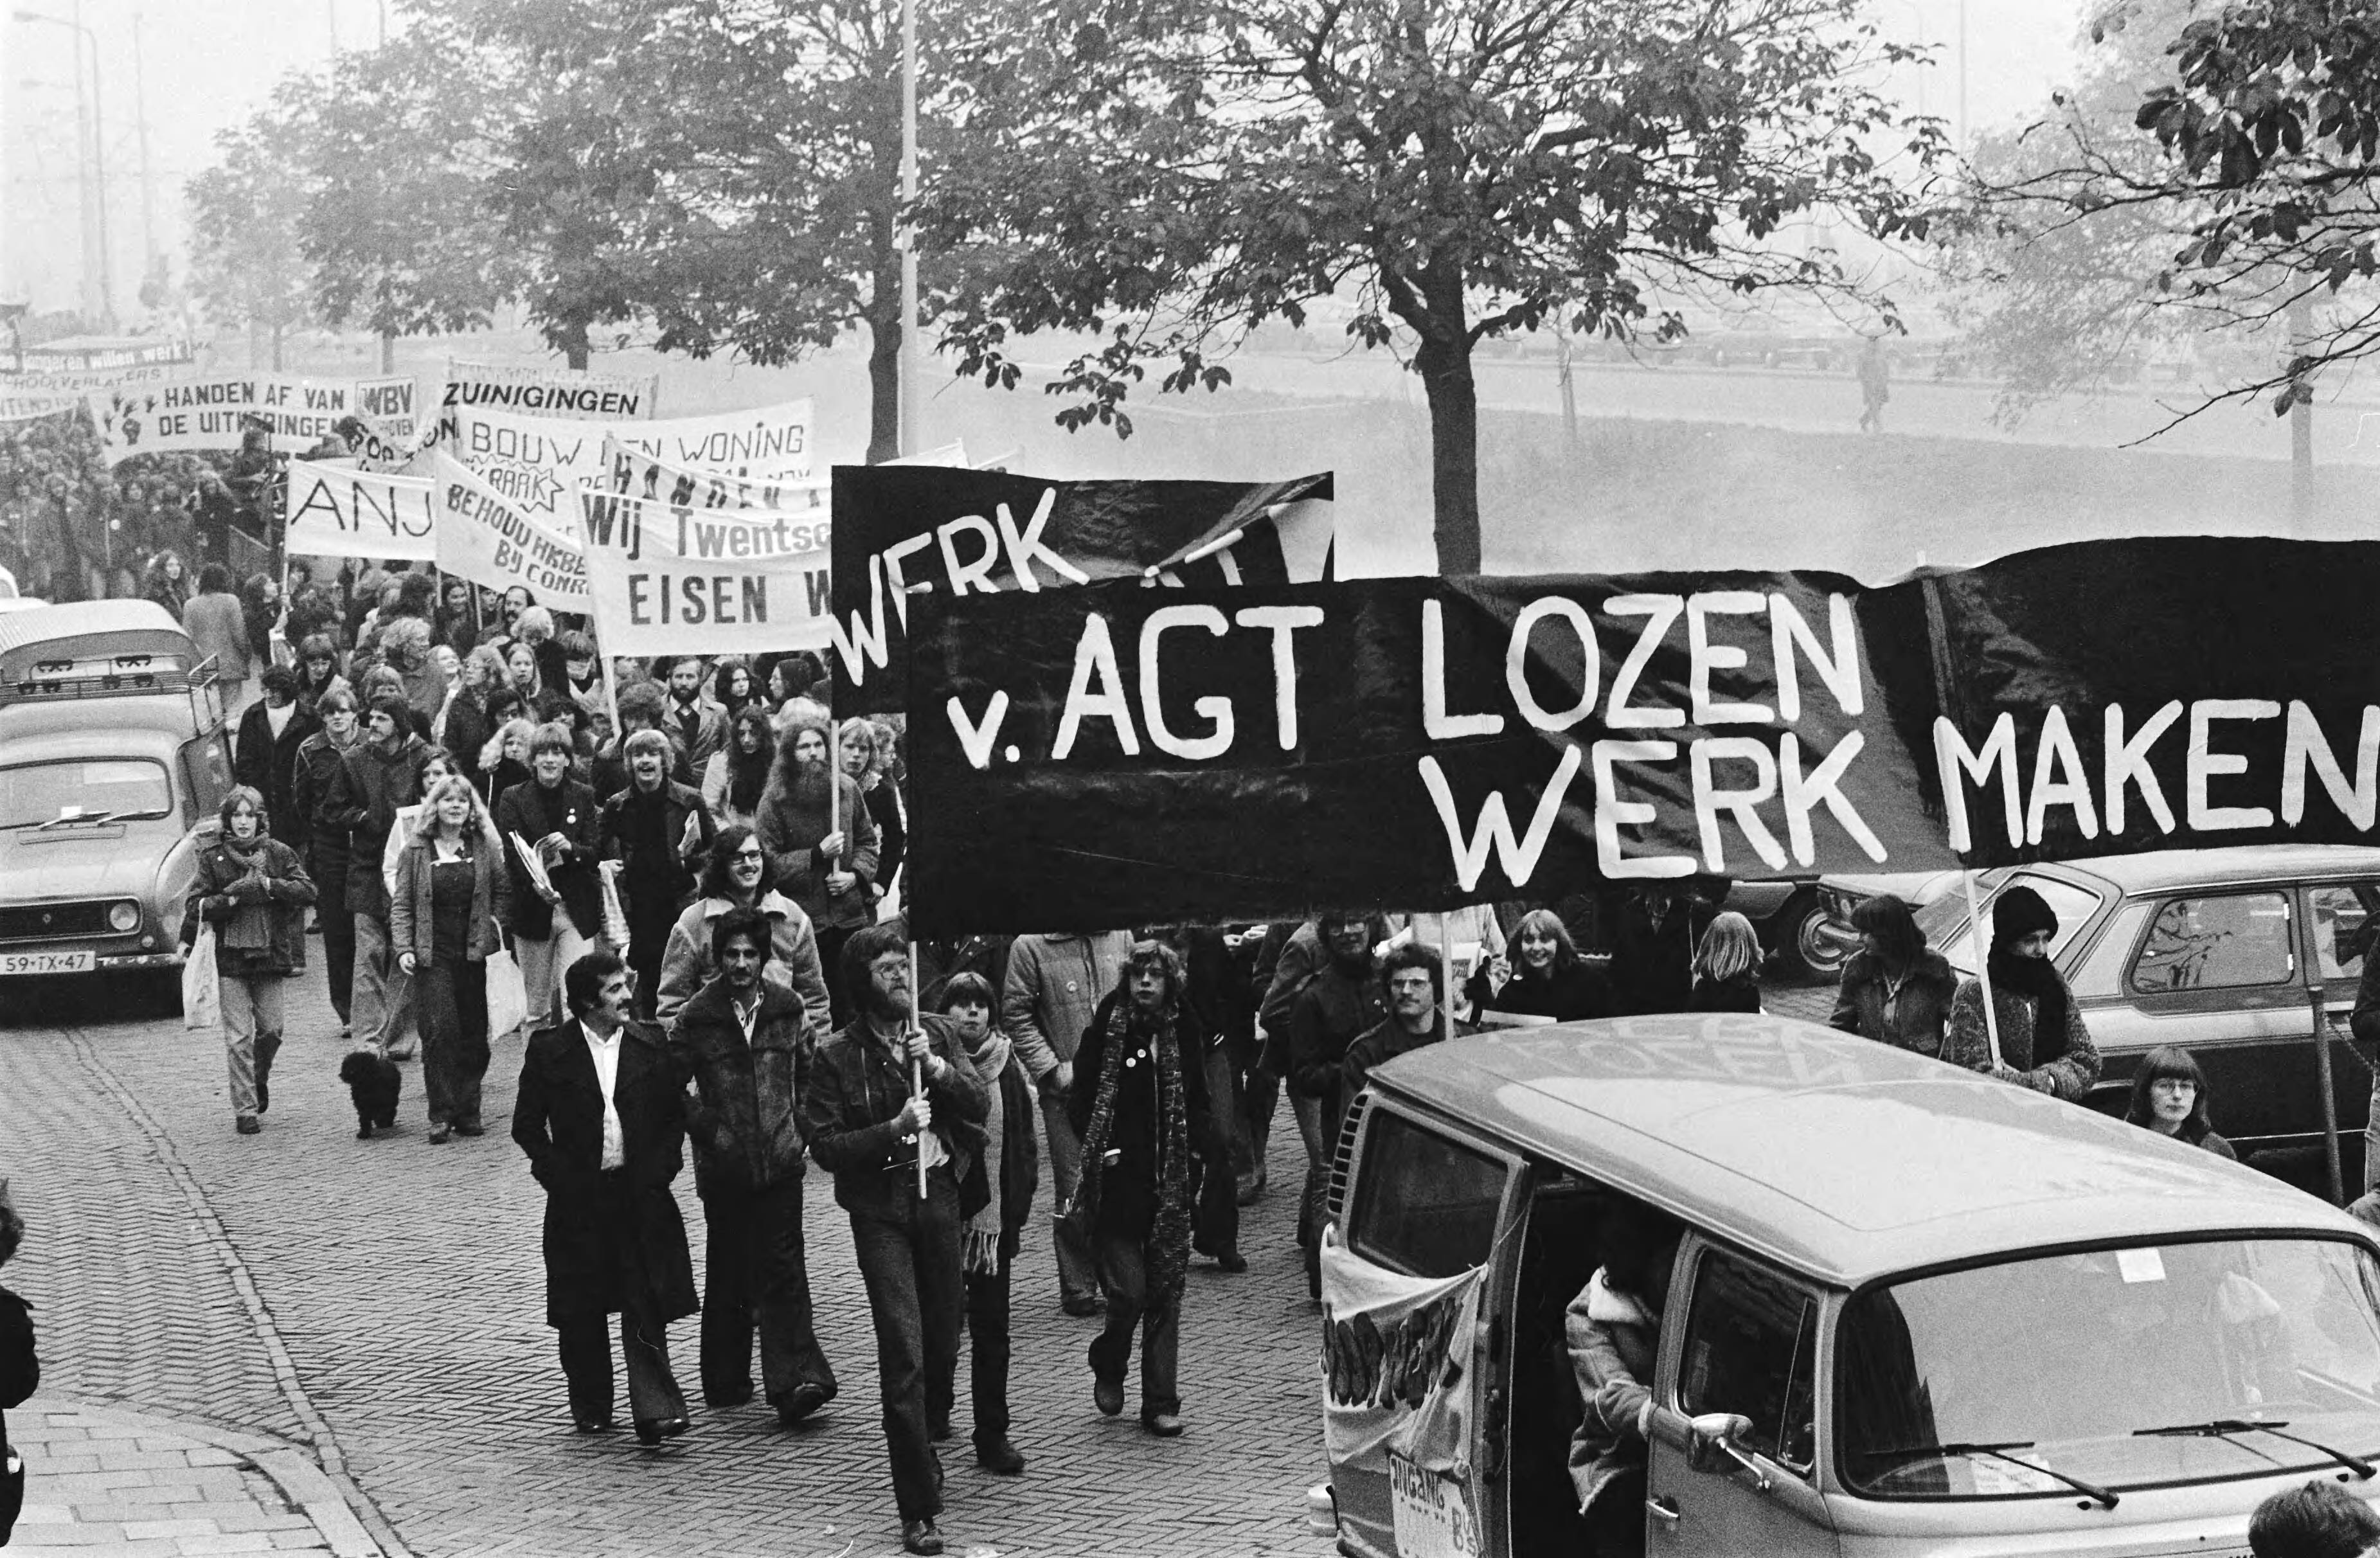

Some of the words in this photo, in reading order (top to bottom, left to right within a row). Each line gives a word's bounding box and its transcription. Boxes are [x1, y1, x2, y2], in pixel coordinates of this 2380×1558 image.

[165, 382, 255, 408] HANDEN
[265, 384, 292, 406] AF
[305, 388, 344, 410] VAN
[361, 383, 413, 416] WBV
[443, 382, 638, 415] ZUINIGINGEN
[159, 415, 188, 437] DE
[472, 422, 583, 467] BOUW
[471, 466, 548, 500] RAAK
[291, 478, 432, 537] ANJ
[582, 494, 642, 561] Wij
[526, 563, 587, 596] CONR
[628, 573, 768, 625] EISEN
[831, 487, 1091, 686] WERK
[1051, 605, 1324, 760] AGT
[1422, 591, 1865, 739] LOZEN
[1418, 730, 1888, 891] WERK
[1933, 699, 2380, 853] MAKEN
[6, 954, 86, 971] 59-TX-47
